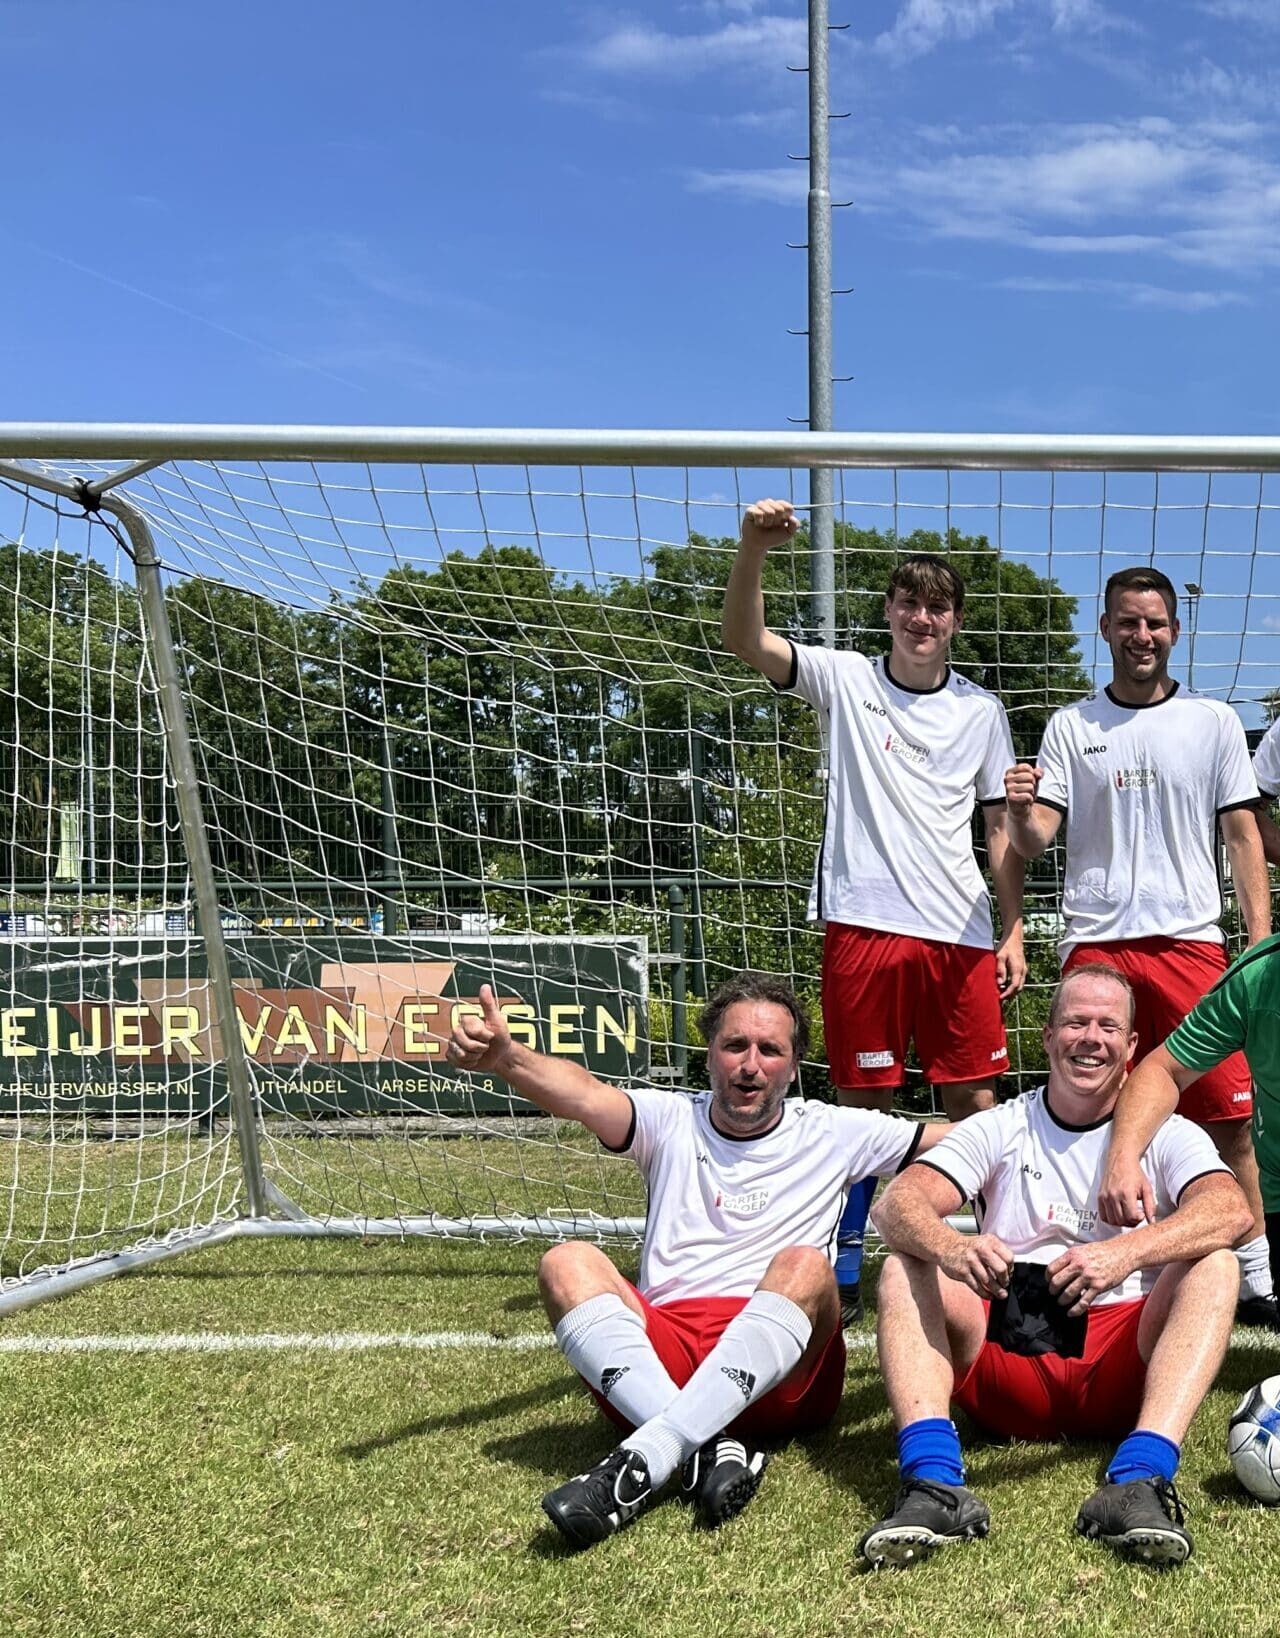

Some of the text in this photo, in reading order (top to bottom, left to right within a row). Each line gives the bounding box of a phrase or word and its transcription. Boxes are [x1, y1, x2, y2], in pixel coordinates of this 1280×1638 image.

[1083, 745, 1107, 756] JAKO
[1123, 768, 1157, 778] BARTEN
[1124, 778, 1155, 788] GROEP
[1, 1007, 204, 1057] EIJER
[236, 1004, 367, 1056] VAN
[0, 1079, 494, 1096] .REIJERVANESSEN.NL UTHANDEL ARSENAAL 8
[724, 1190, 769, 1205] ARTEN
